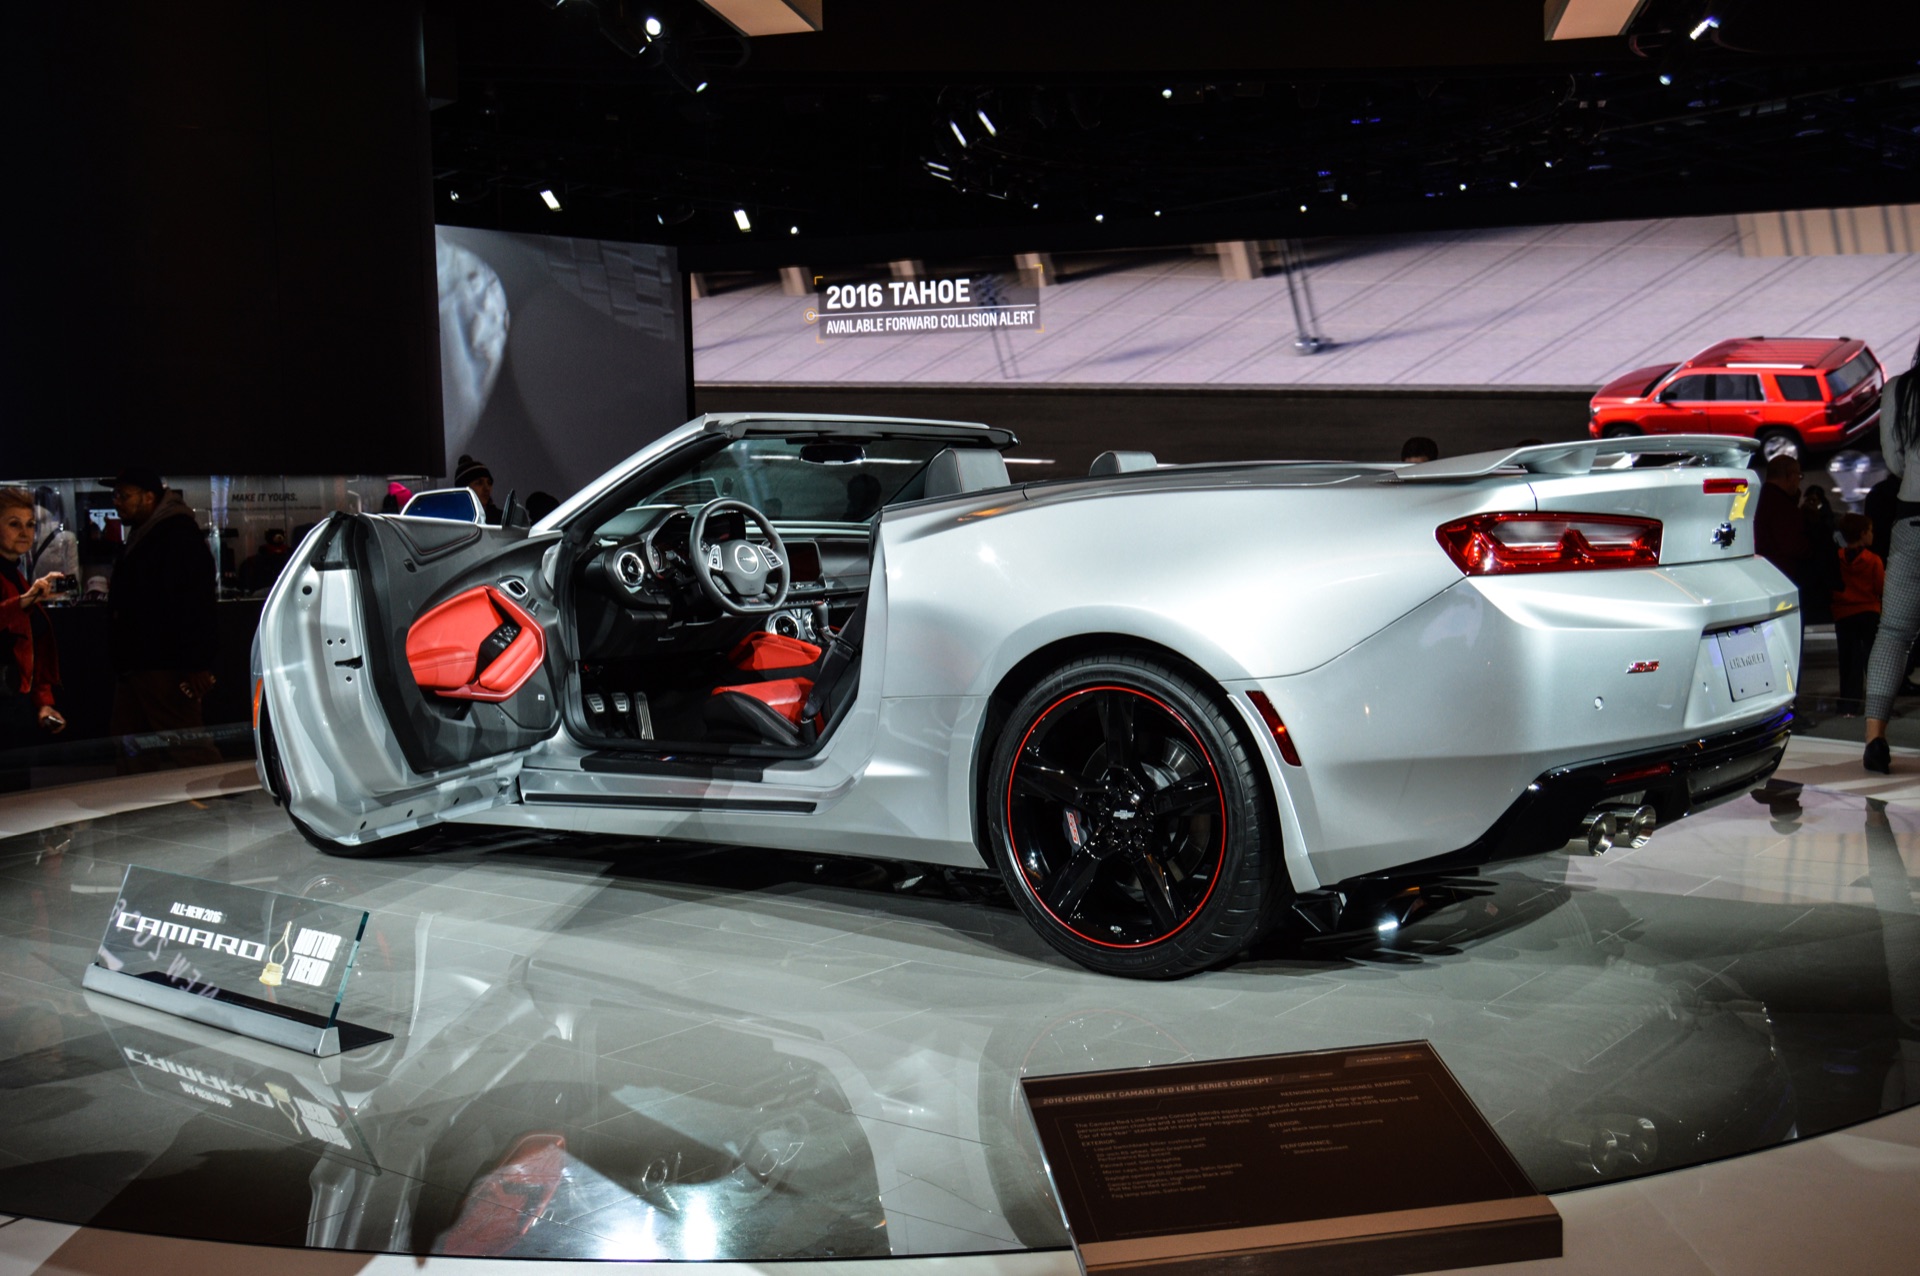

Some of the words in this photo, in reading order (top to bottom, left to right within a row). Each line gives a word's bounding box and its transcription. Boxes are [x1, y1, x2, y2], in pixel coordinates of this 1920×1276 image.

[826, 283, 883, 309] 2016
[888, 278, 970, 306] TAHOE
[826, 318, 884, 334] AVAILABLE
[886, 315, 938, 332] FORWARD
[940, 312, 998, 329] COLLISION
[999, 310, 1035, 326] ALERT
[232, 493, 256, 502] MAKE
[257, 493, 267, 502] IT
[268, 492, 298, 502] YOURS.
[1730, 653, 1765, 670] CHEVROLET
[170, 901, 206, 920] ALL-NEW
[203, 908, 224, 924] 2016
[115, 911, 267, 961] CAMARO
[292, 927, 342, 961] MOTOR
[286, 954, 331, 987] TREND
[1064, 1091, 1117, 1102] CHEVROLET
[1118, 1088, 1155, 1097] CAMARO
[1156, 1086, 1174, 1094] RED
[1176, 1084, 1196, 1092] LINE
[1197, 1081, 1228, 1090] SERIES
[1168, 1112, 1196, 1120] Concept
[1349, 1094, 1374, 1102] greater
[1270, 1107, 1298, 1115] another
[1298, 1104, 1327, 1112] example
